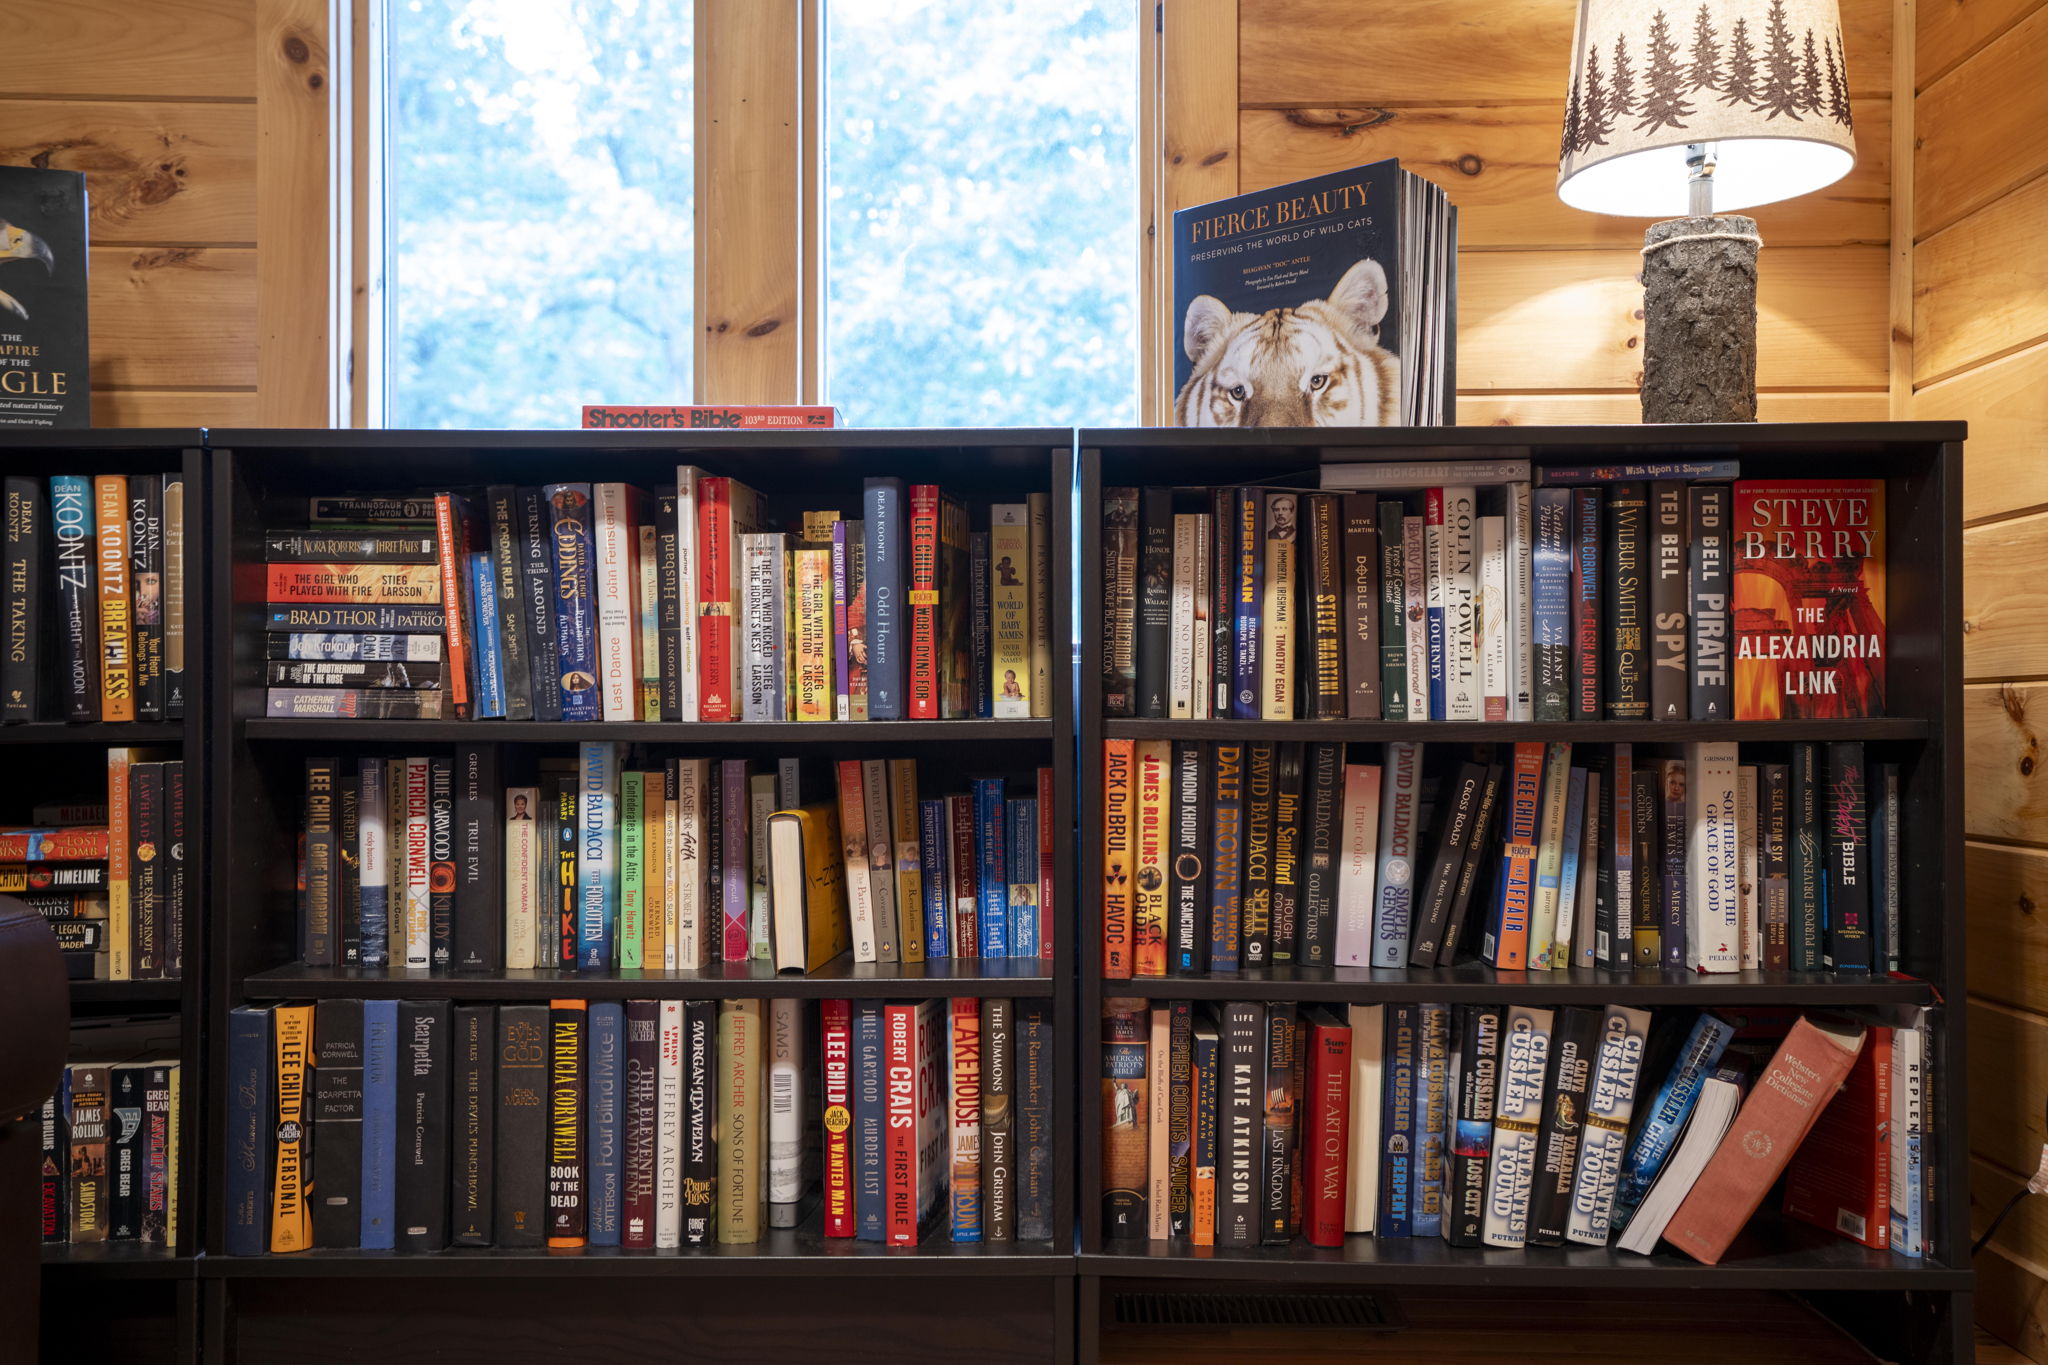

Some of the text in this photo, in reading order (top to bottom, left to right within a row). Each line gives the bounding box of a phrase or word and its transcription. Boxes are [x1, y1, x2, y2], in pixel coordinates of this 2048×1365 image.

[1191, 217, 1372, 262] PRESERVING THE WORLD OF WILD CATS
[1192, 182, 1373, 243] FIERCE BEAUTY
[0, 371, 66, 394] GLE
[39, 403, 64, 411] history
[589, 408, 684, 429] Shooter's
[690, 410, 741, 428] Bible
[767, 416, 802, 425] EDITION
[9, 492, 32, 542] DEAN KOONTZ
[55, 493, 86, 590] KOONTZ
[102, 484, 122, 594] DEAN KOONTZ
[877, 521, 886, 562] KOONTZ
[915, 517, 933, 541] LEE
[1661, 491, 1678, 579] TED BELL
[1702, 493, 1719, 581] TED BELL
[1752, 500, 1869, 527] STEVE
[915, 544, 933, 583] CHILD
[1242, 500, 1254, 602] SUPER BRAIN
[1741, 531, 1878, 559] BERRY
[290, 586, 372, 596] PLAYED WITH FIRE
[295, 575, 358, 584] THE GIRL WHO
[382, 576, 407, 585] STIEG
[382, 587, 422, 596] LARSSON
[1430, 529, 1440, 681] AMERICAN JOURNEY
[1457, 498, 1472, 683] COLIN POWELL
[1838, 586, 1859, 594] Novel
[12, 559, 26, 663] THE TAKING
[291, 610, 376, 625] BRAD THOR
[877, 586, 889, 663] Odd Hours
[1697, 593, 1725, 686] PIRATE
[1797, 608, 1825, 624] THE
[70, 610, 85, 694] LIGHT MOON
[103, 600, 129, 700] BREATHLESS
[915, 607, 930, 699] WORTH DYING FOR
[1275, 634, 1286, 702] TIMOTHY EGAN
[1316, 594, 1339, 695] STEVE MARTINI
[1656, 613, 1685, 671] SPY
[1739, 634, 1881, 659] ALEXANDRIA
[294, 696, 335, 704] CATHERINE
[611, 638, 622, 711] Last Dance
[1785, 669, 1837, 694] LINK
[293, 705, 335, 713] MARSHALL
[469, 753, 478, 801] GREG ILES
[1109, 752, 1127, 789] JACK
[408, 764, 427, 888] PATRICIA CORNWELL
[560, 792, 568, 820] MAGARY
[585, 747, 603, 861] DAVID BALDACCI
[626, 780, 638, 832] Confederates
[1142, 754, 1159, 864] JAMES ROLLINS
[1215, 747, 1240, 890] DALE BROWN
[54, 870, 101, 884] TIMELINE
[468, 820, 478, 883] TRUE EVIL
[626, 846, 638, 858] the
[626, 861, 638, 881] Attic
[1707, 804, 1719, 911] GRACE OF GOD
[1843, 842, 1855, 885] BIBLE
[144, 866, 153, 953] THE ENDLESS KNOT
[585, 870, 604, 941] THE FORGOTTEN
[625, 889, 637, 939] Tony Horwitz
[1107, 894, 1125, 943] HAVOC
[1180, 885, 1194, 949] THE SANCTUARY
[282, 1042, 301, 1115] LEE CHILD
[733, 1016, 745, 1107] JEFFREY ARCHER
[827, 1032, 846, 1102] LEE CHILD
[890, 1013, 912, 1128] ROBERT CRAIS
[1594, 1016, 1626, 1111] CUSSLER
[1617, 1035, 1642, 1099] CLIVE
[1784, 1053, 1823, 1083] Webster's
[553, 1022, 577, 1162] PATRICIA CORNWELL
[1909, 1064, 1918, 1164] REPLENISH
[73, 1126, 103, 1138] ROLLINS
[1232, 1065, 1251, 1203] KATE ATKINSON
[1323, 1070, 1342, 1200] THE ART OF WAR
[120, 1149, 130, 1196] GREG BEAR
[280, 1148, 297, 1217] PERSONAL
[550, 1166, 579, 1178] BOOK
[732, 1114, 743, 1224] SONS OF FORTUNE
[831, 1143, 845, 1186] WANTED
[895, 1150, 907, 1187] FIRST
[1392, 1156, 1408, 1221] SERPENT
[1577, 1145, 1604, 1212] FOUND
[1592, 1136, 1623, 1229] ATLANTIS
[80, 1182, 95, 1231] SANDSTORM
[550, 1195, 578, 1207] DEAD
[832, 1190, 845, 1215] MAN
[895, 1193, 908, 1224] RULE
